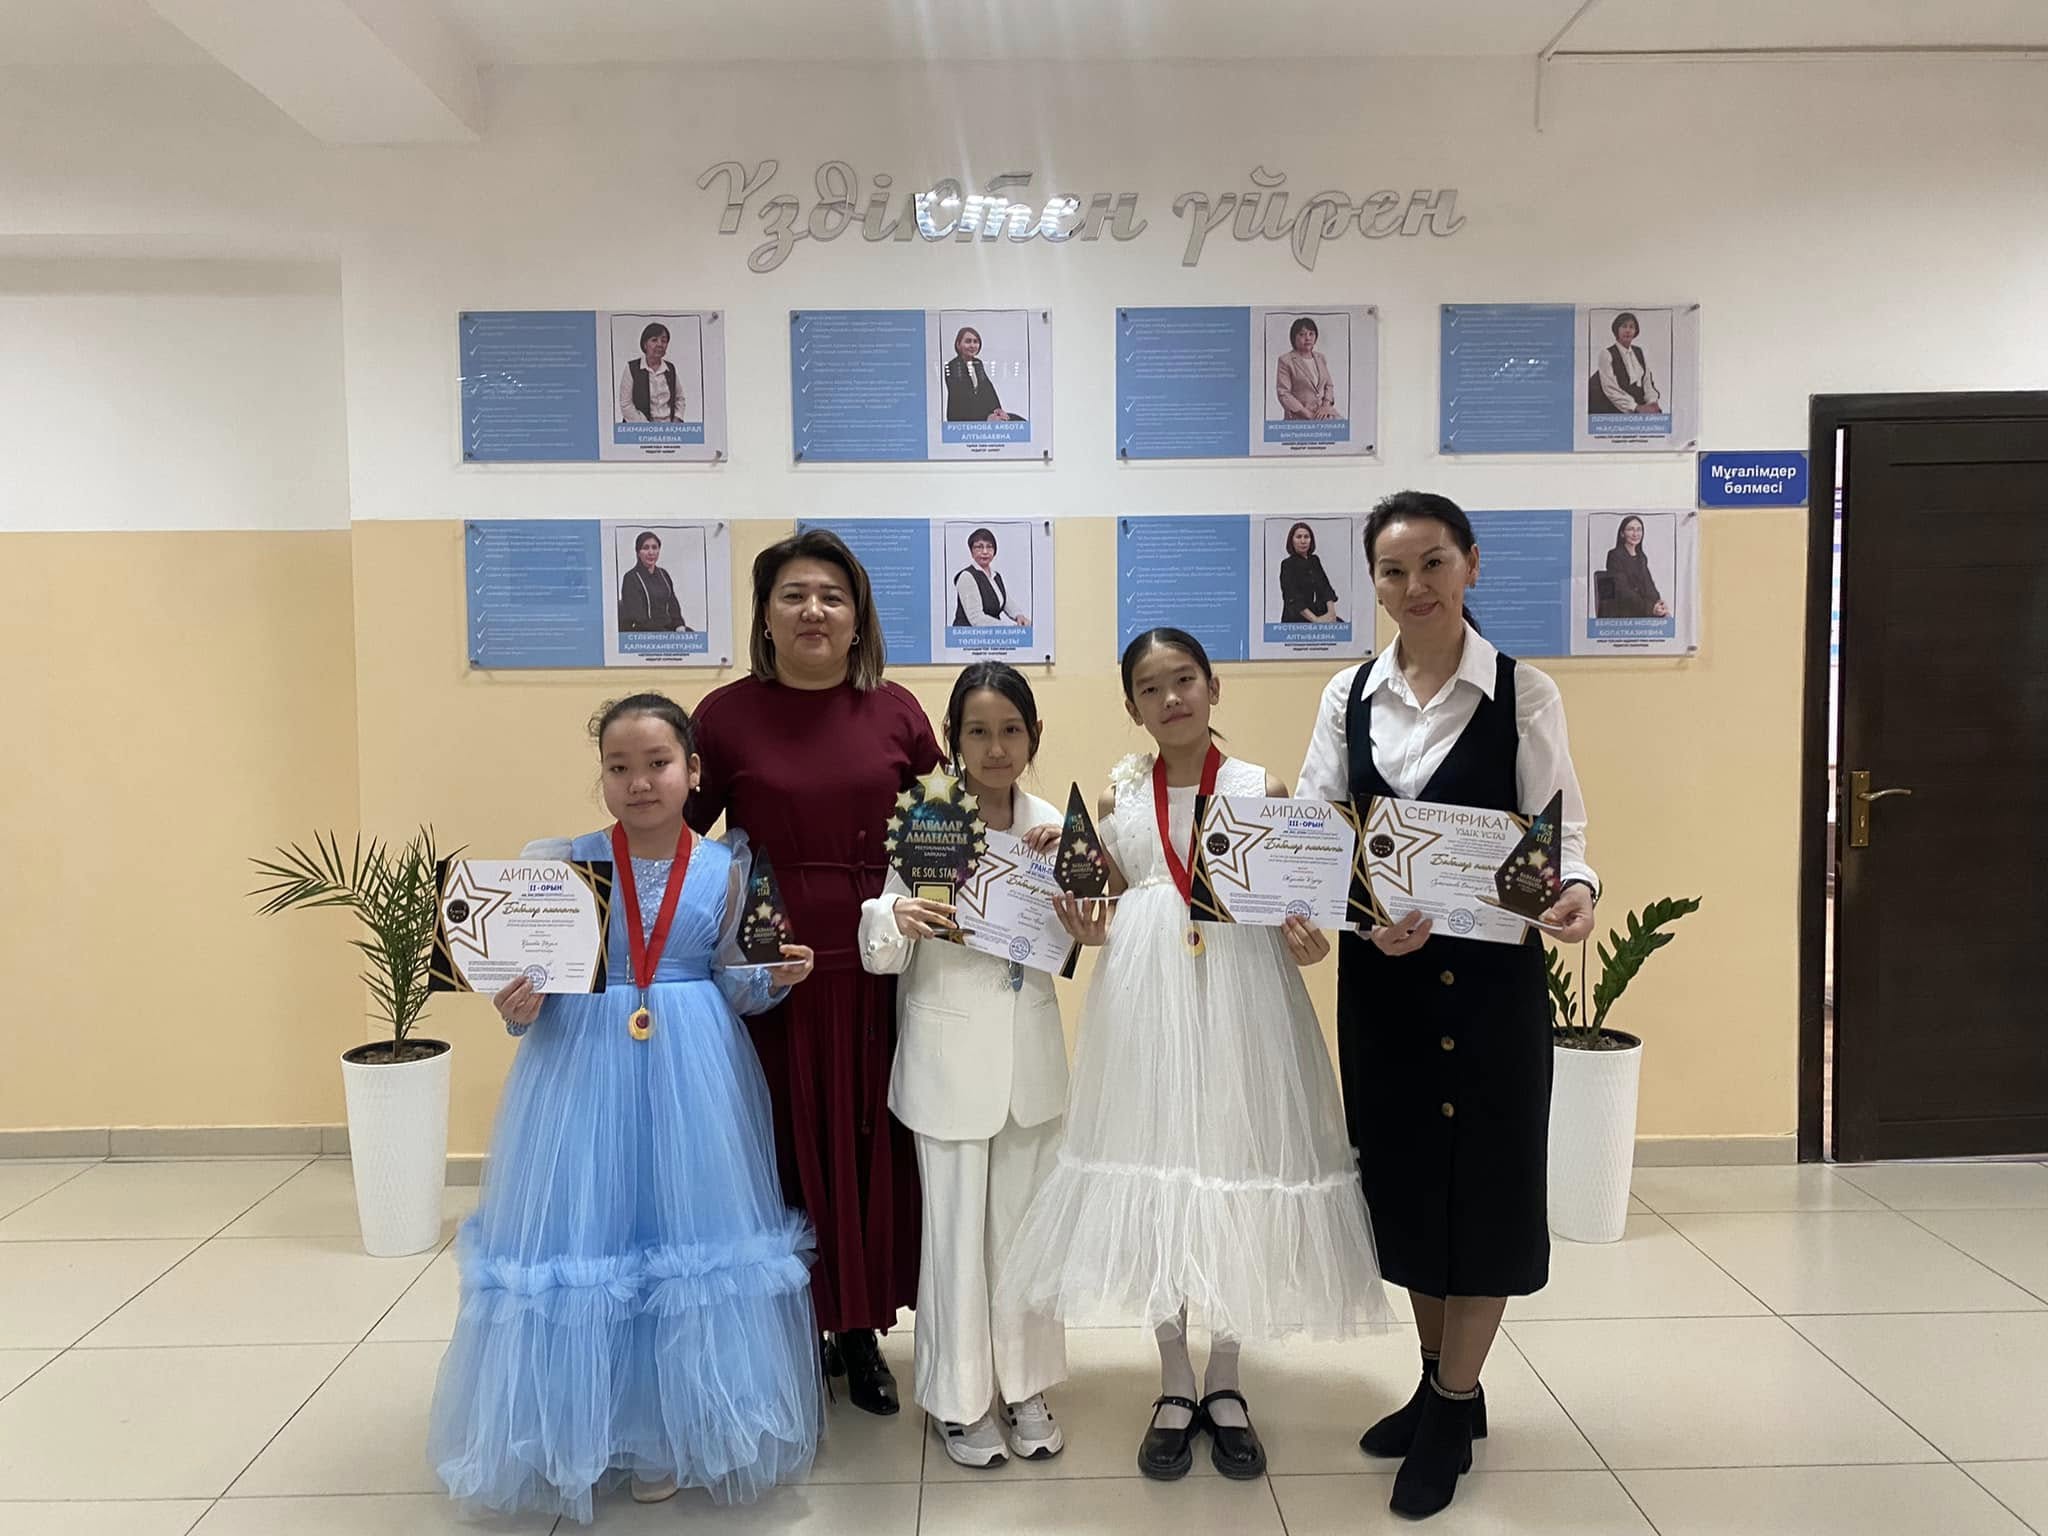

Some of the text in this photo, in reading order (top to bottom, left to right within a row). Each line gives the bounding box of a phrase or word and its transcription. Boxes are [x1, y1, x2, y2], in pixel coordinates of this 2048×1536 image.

[1173, 165, 1467, 271] үйрен
[1711, 464, 1797, 480] Мұғалімдер
[1724, 481, 1783, 494] бөлмесі
[1260, 804, 1332, 820] ДИПЛОМ
[1404, 806, 1512, 831] СЕРТИФИКАТ
[911, 819, 964, 832] БАБАЛАР
[904, 831, 969, 845] АМАНАТЫ
[499, 868, 569, 882] ДИПЛОМ
[911, 867, 958, 880] RE SOL STAR
